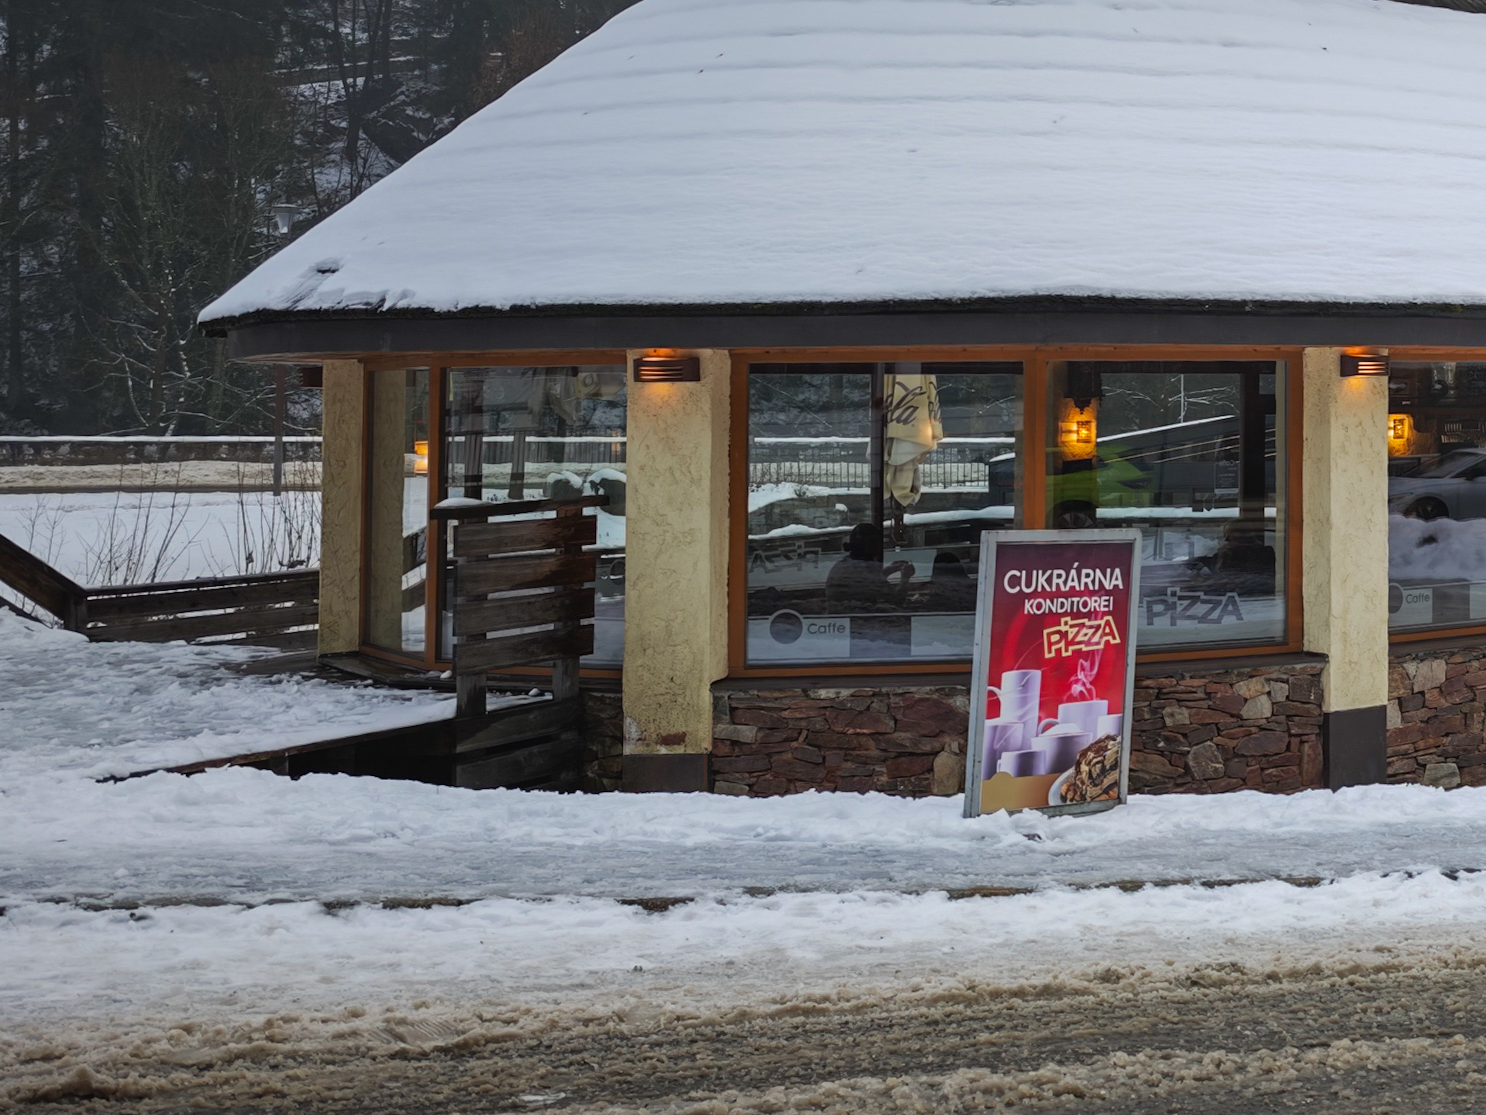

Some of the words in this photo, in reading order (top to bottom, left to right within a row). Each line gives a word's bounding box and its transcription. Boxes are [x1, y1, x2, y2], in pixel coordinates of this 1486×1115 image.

[1003, 562, 1123, 594] CUKRÁRNA
[1024, 595, 1114, 615] KONDITOREI
[1405, 592, 1430, 604] Caffe
[807, 620, 846, 635] Caffe
